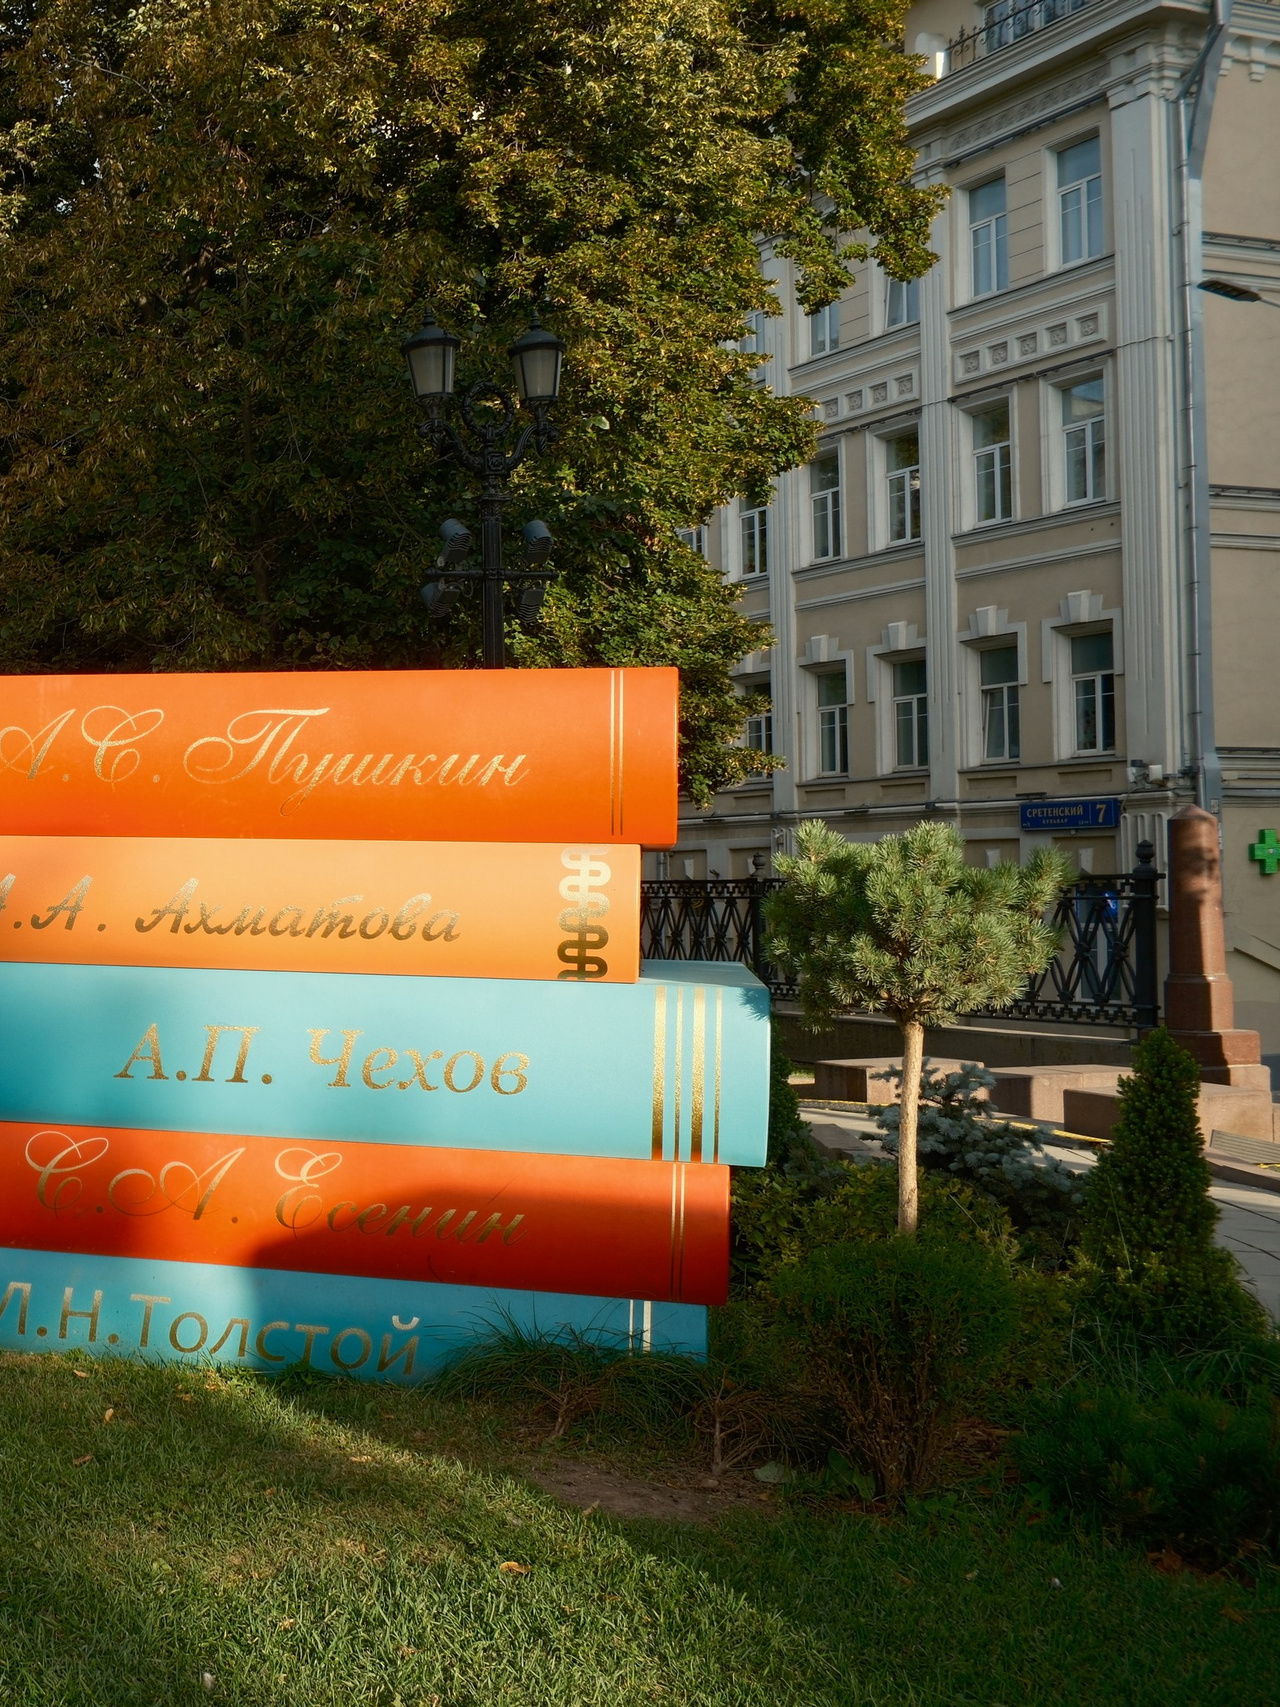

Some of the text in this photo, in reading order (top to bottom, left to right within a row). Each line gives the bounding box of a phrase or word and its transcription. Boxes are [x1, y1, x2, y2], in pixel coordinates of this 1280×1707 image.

[182, 706, 529, 817] Пушкин
[1027, 805, 1083, 817] СРЕТЕНСКИЙ
[1096, 804, 1107, 822] 7
[135, 876, 462, 943] Ахматова
[112, 1023, 529, 1097] А.П. Чехов
[273, 1147, 528, 1246] Есенин
